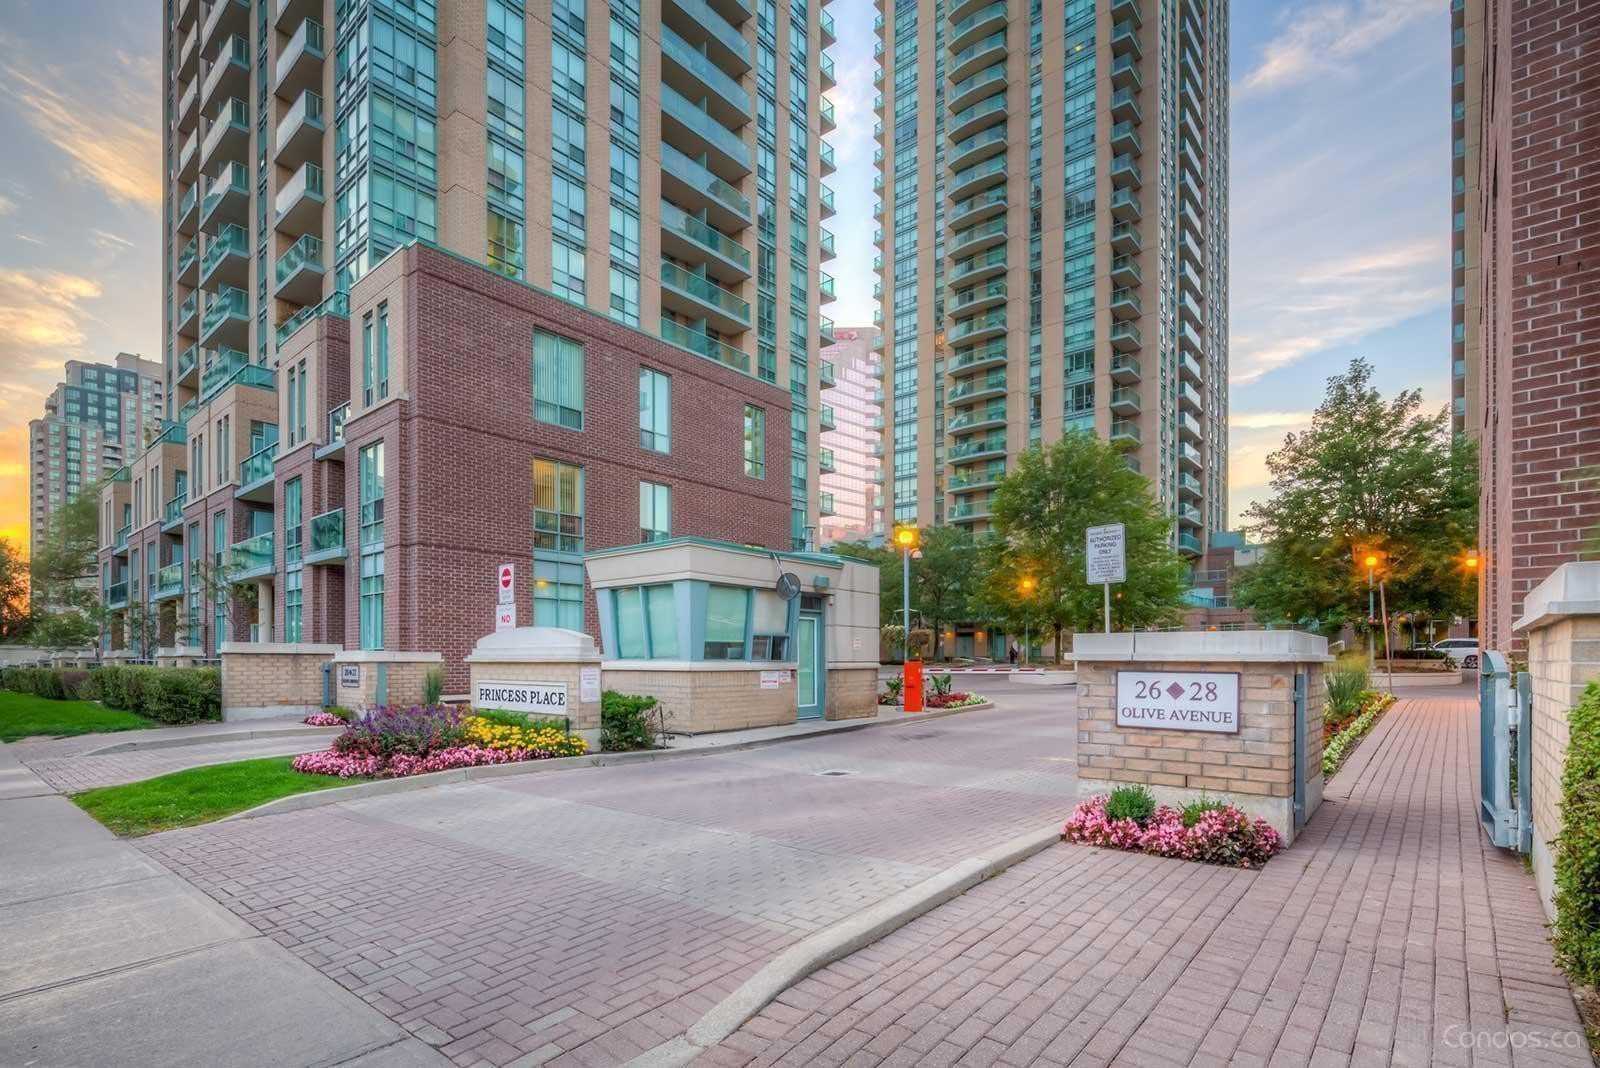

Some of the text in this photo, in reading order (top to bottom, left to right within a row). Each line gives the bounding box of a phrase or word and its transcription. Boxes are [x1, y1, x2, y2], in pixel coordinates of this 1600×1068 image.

[501, 614, 511, 624] NO
[480, 688, 566, 706] PRINCESS PLACE
[1135, 681, 1218, 702] 26 28
[1121, 707, 1233, 724] OLIVE AVENUE
